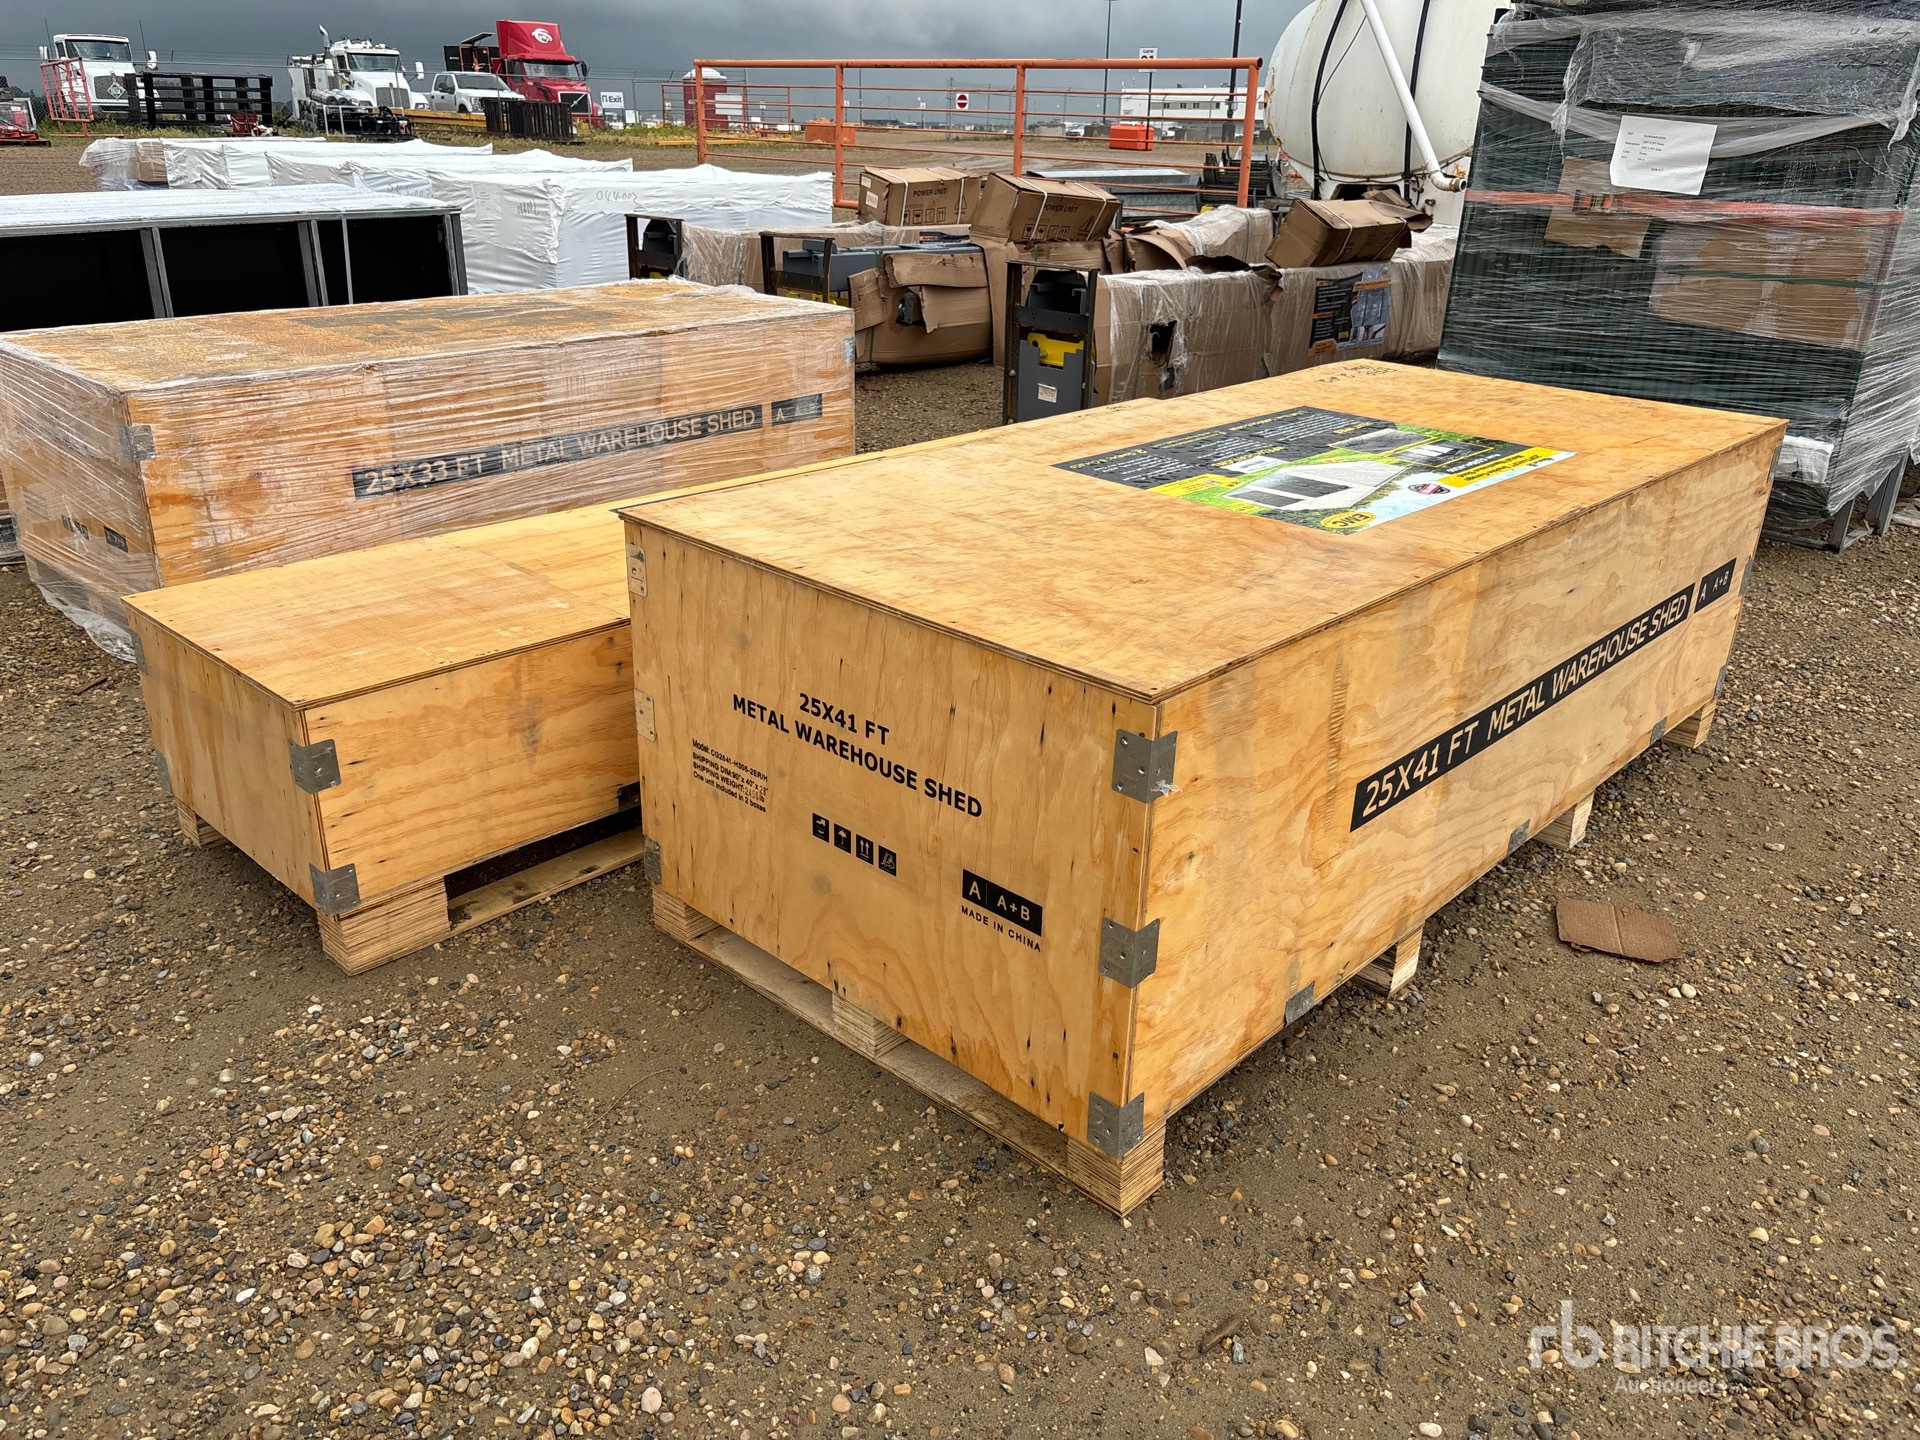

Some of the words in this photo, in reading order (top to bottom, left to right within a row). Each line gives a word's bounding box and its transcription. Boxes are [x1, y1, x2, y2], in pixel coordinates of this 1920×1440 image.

[913, 189, 933, 197] POWER
[365, 460, 448, 494] 25X33
[458, 454, 485, 477] FT
[576, 420, 702, 455] WAREHOUSE
[706, 409, 755, 432] SHED
[1332, 514, 1370, 527] EMC
[1699, 583, 1706, 603] A
[1712, 570, 1729, 592] A+B
[800, 692, 857, 734] 25X41
[865, 720, 890, 745] FT
[1362, 747, 1439, 817] 25X41
[1446, 720, 1479, 765] FT
[1486, 682, 1546, 740] METAL
[1552, 616, 1648, 698] WAREHOUSE
[1649, 594, 1688, 637] SHED
[692, 738, 710, 754] Model:
[692, 752, 719, 770] SHIPPING
[733, 694, 790, 734] METAL
[795, 720, 917, 790] WAREHOUSE
[924, 778, 982, 818] SHED
[693, 761, 719, 780] SHIPPING
[693, 771, 704, 781] One
[705, 778, 715, 787] unit
[716, 781, 737, 798] included
[739, 794, 743, 802] in
[750, 799, 766, 813] boxes
[969, 881, 981, 900] A
[997, 895, 1030, 921] A+B
[961, 905, 988, 926] MADE
[994, 921, 1003, 933] IN
[1008, 929, 1041, 952] CHINA
